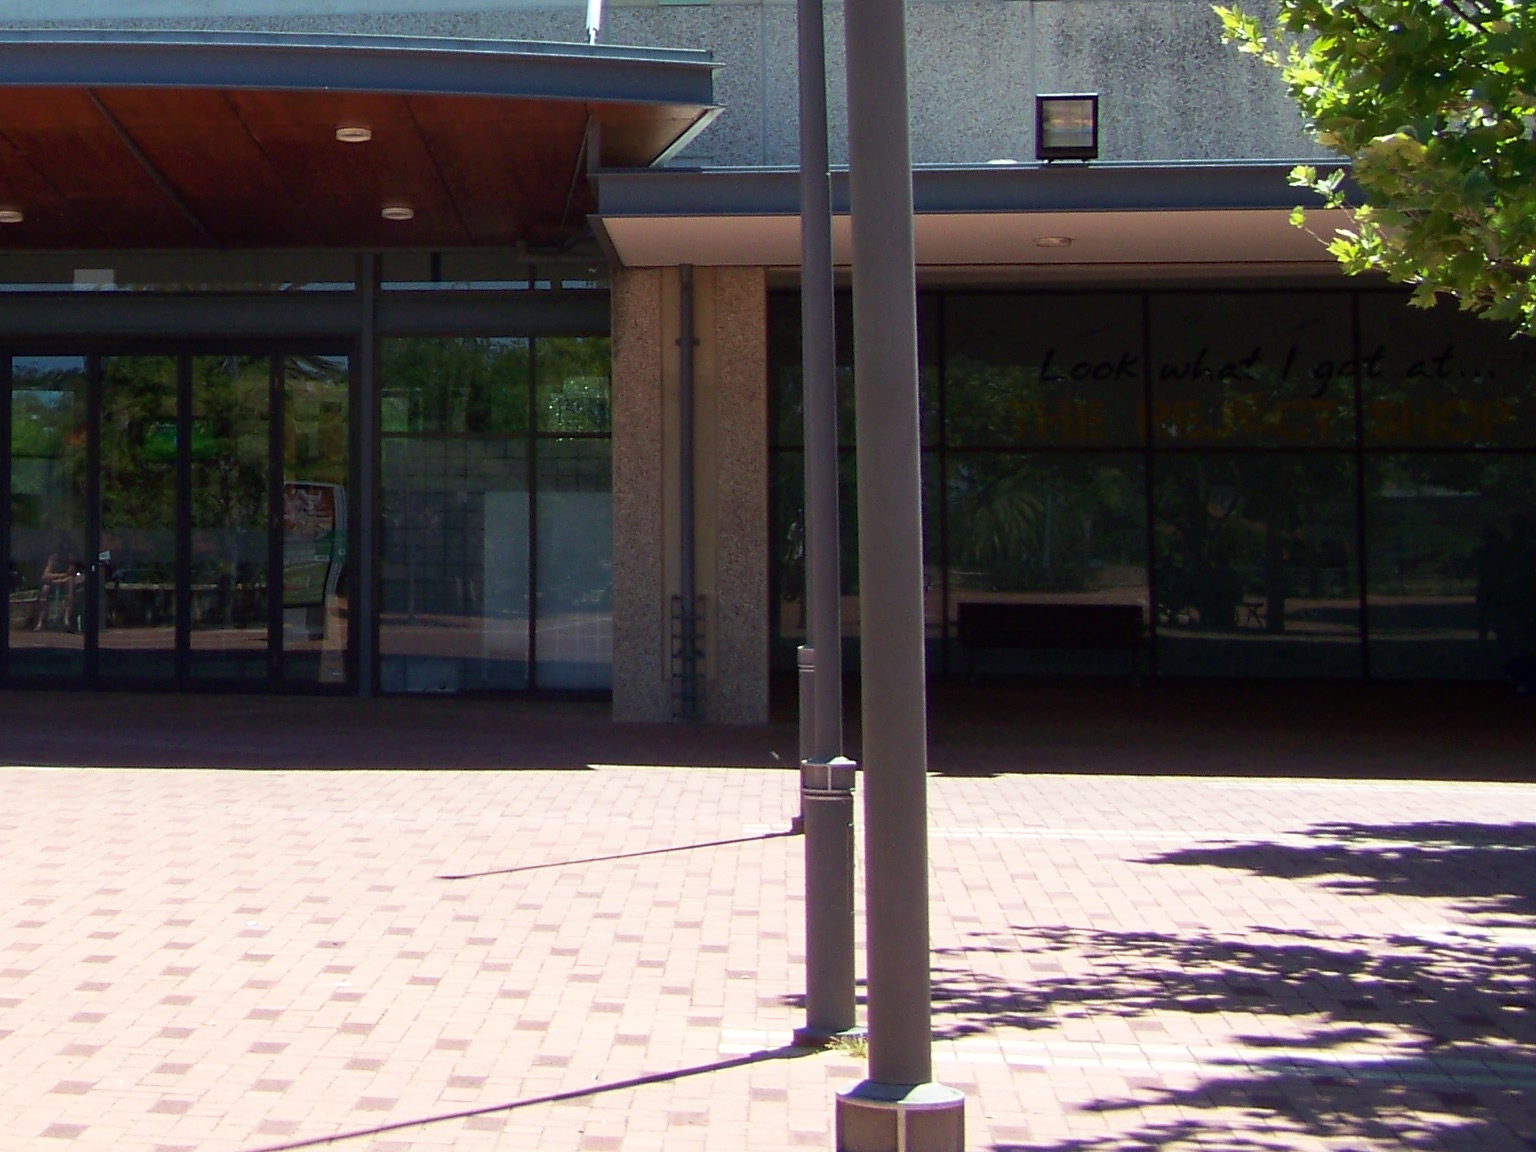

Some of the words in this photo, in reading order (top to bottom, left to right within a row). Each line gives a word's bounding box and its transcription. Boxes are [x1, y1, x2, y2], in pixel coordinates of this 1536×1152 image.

[1038, 348, 1139, 383] Look
[1160, 346, 1262, 383] what
[1280, 347, 1297, 381] I
[1311, 345, 1384, 398] got
[1008, 398, 1106, 440] THE
[1137, 393, 1337, 440] REJECT
[1370, 397, 1515, 440] SHOP
